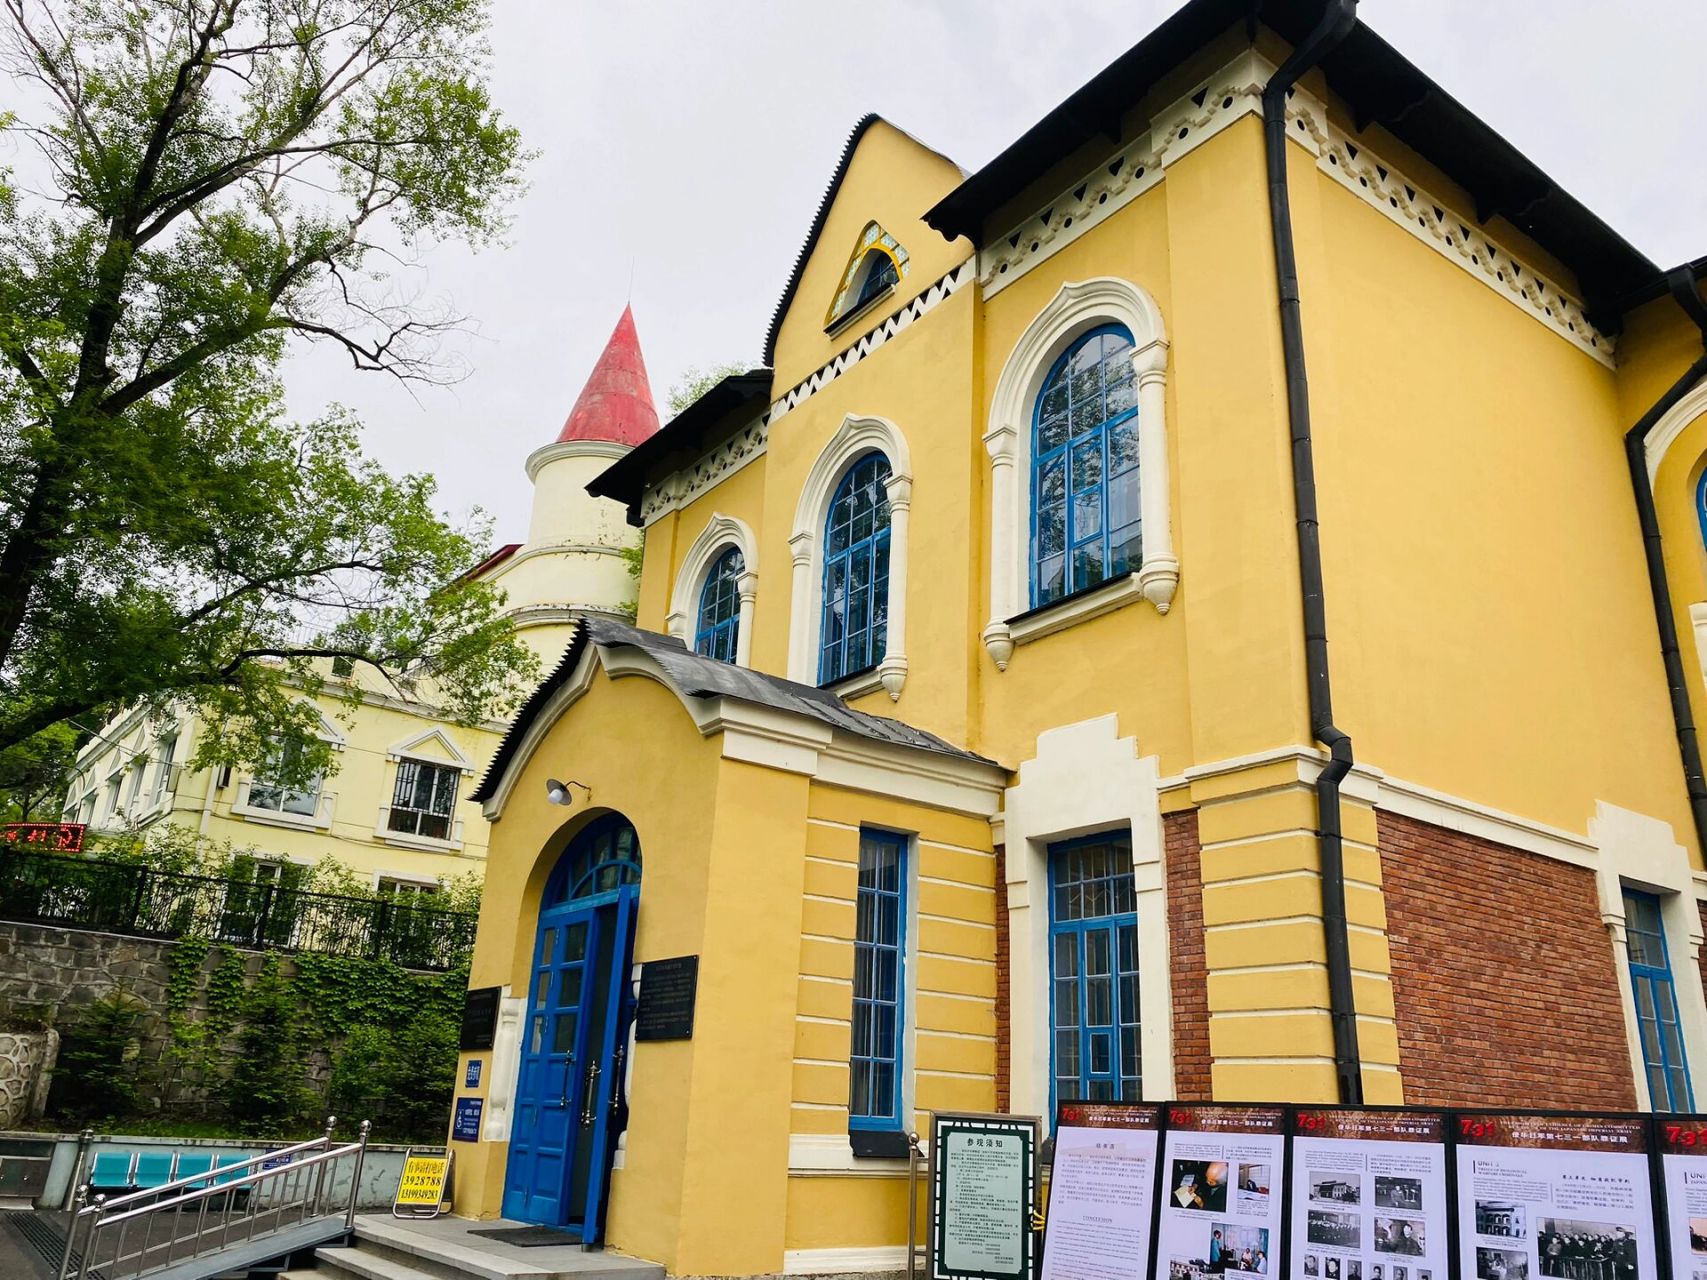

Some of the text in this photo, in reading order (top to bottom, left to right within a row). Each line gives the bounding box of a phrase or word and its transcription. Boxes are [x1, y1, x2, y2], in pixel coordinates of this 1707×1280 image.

[1297, 1113, 1326, 1130] 731
[1460, 1119, 1496, 1137] 731
[404, 1175, 442, 1186] 3928788
